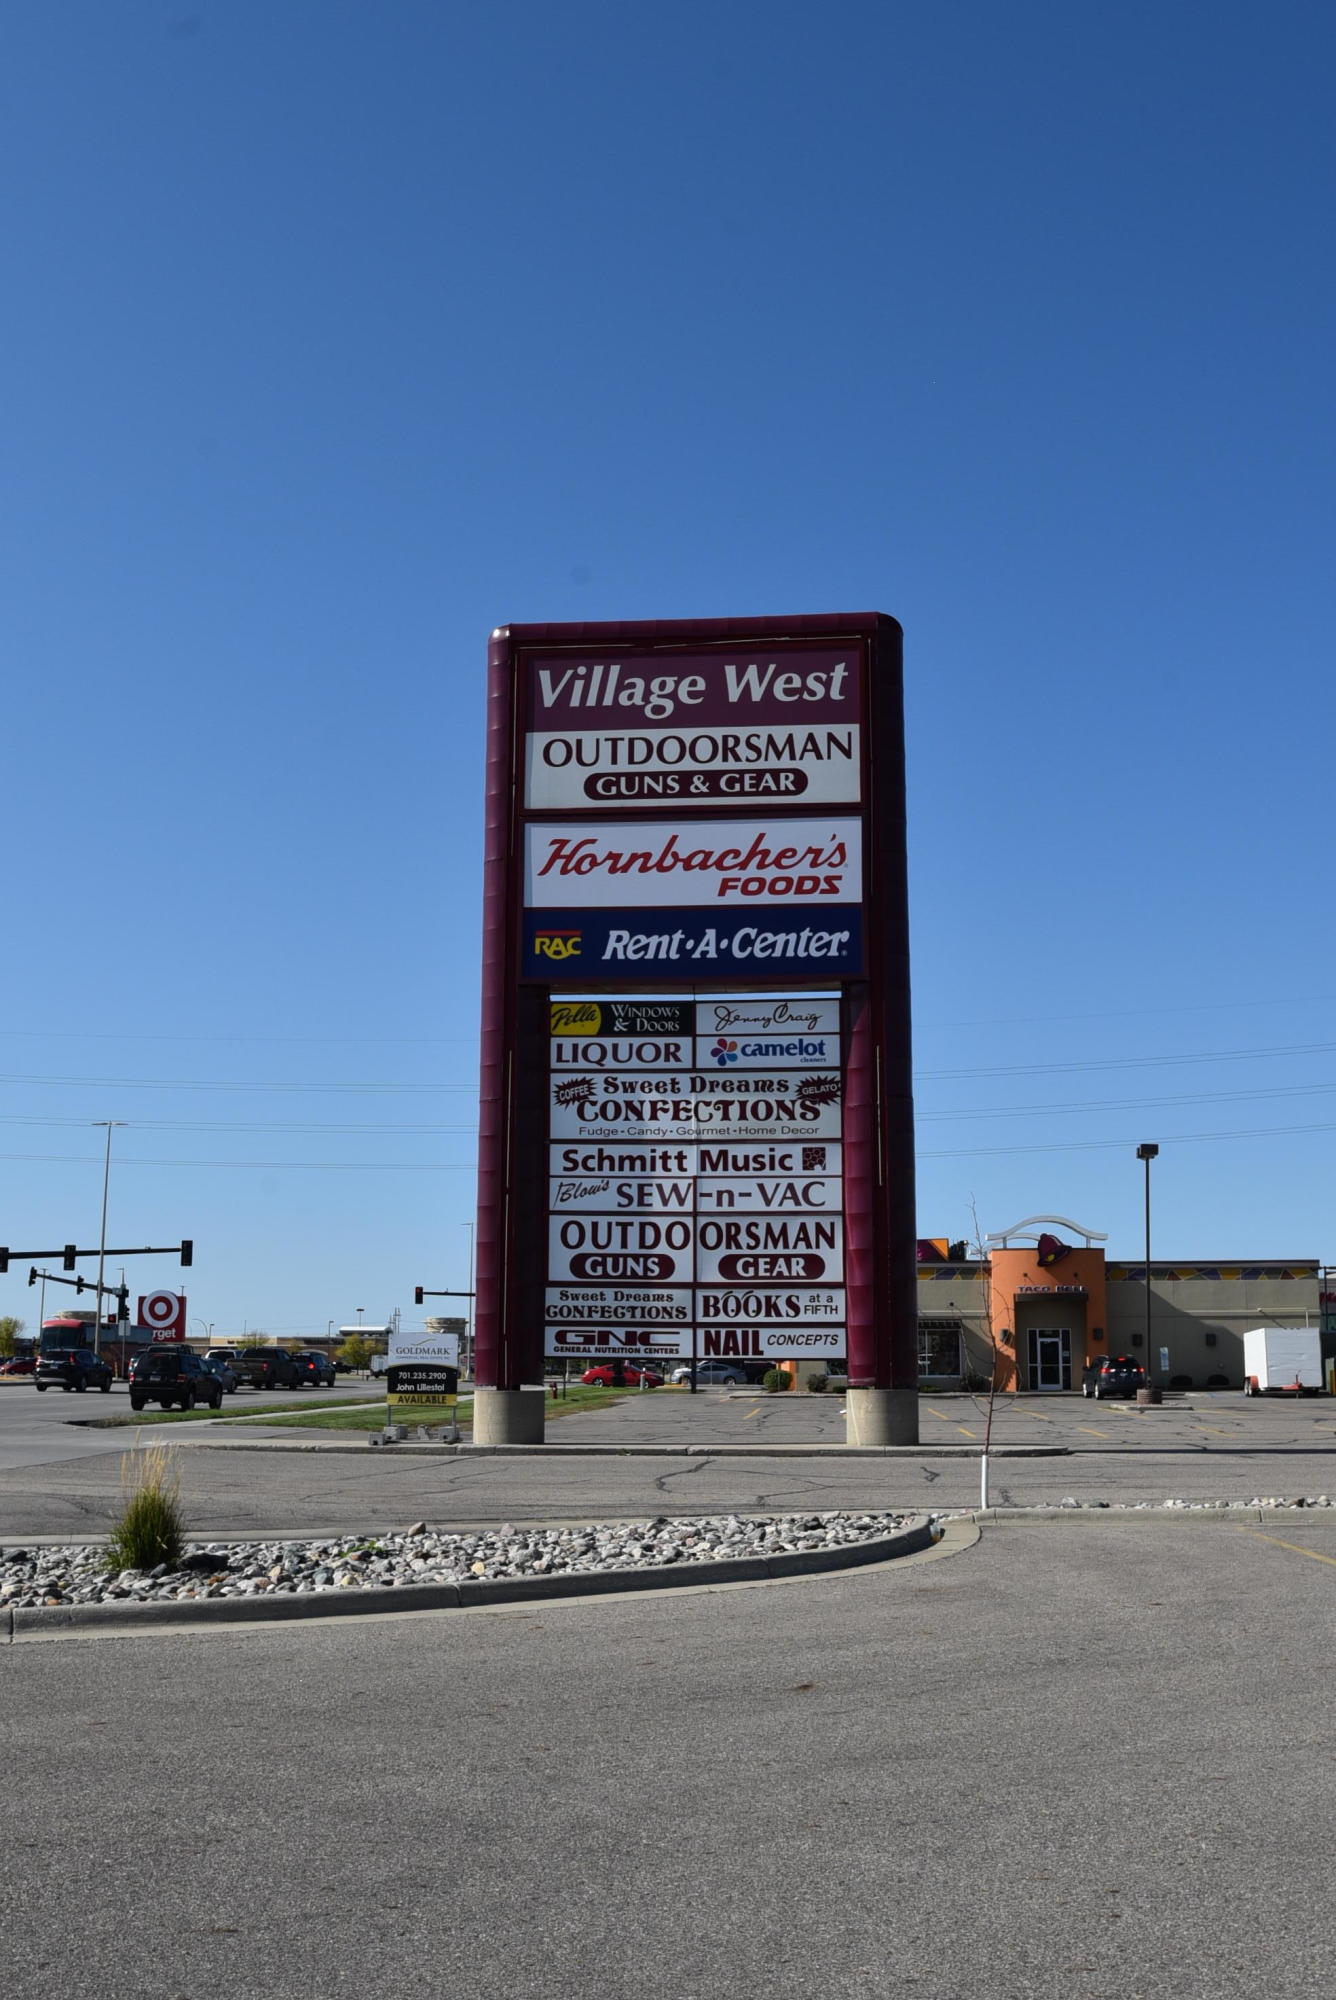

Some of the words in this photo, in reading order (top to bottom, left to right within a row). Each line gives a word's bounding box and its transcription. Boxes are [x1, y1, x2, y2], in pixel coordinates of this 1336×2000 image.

[538, 664, 706, 720] Village
[724, 661, 849, 703] West
[542, 731, 853, 768] OUTDOORSMAN
[596, 775, 680, 796] GUNS
[690, 775, 710, 793] &
[719, 772, 796, 793] GEAR
[537, 832, 848, 876] Hornbacher's
[717, 875, 843, 897] FOODS
[534, 935, 582, 960] RAC
[551, 1004, 597, 1031] Pella
[613, 1018, 630, 1032] &
[714, 1005, 772, 1032] Jenny
[773, 1002, 823, 1031] Craig
[556, 1042, 683, 1067] LIQUOR
[741, 1038, 826, 1057] camelot
[559, 1084, 590, 1100] COFFEE
[602, 1075, 681, 1095] Sweet
[689, 1075, 790, 1094] Dreams
[802, 1083, 838, 1095] GELATO
[576, 1099, 821, 1123] CONFECTIONS
[579, 1126, 619, 1137] Fudge
[626, 1126, 668, 1137] Candy
[675, 1126, 731, 1136] Gourmet
[738, 1126, 777, 1136] Home
[781, 1125, 820, 1135] Decor
[562, 1148, 688, 1173] Schmitt
[701, 1147, 794, 1172] Music
[584, 1257, 661, 1277] GUNS
[735, 1257, 808, 1277] GEAR
[560, 1290, 607, 1302] Sweet
[614, 1290, 674, 1302] Dreams
[809, 1294, 821, 1303] at
[1016, 1285, 1051, 1293] TACO
[546, 1304, 687, 1319] CONFECTIONS
[702, 1290, 801, 1318] BOOKS
[804, 1305, 838, 1315] FIFTH
[152, 1328, 176, 1340] rget
[555, 1330, 680, 1346] GNC
[704, 1330, 764, 1356] NAIL
[767, 1334, 839, 1346] CONCEPTS
[396, 1347, 450, 1355] GOLDMARK
[397, 1395, 447, 1404] AVAILABLE
